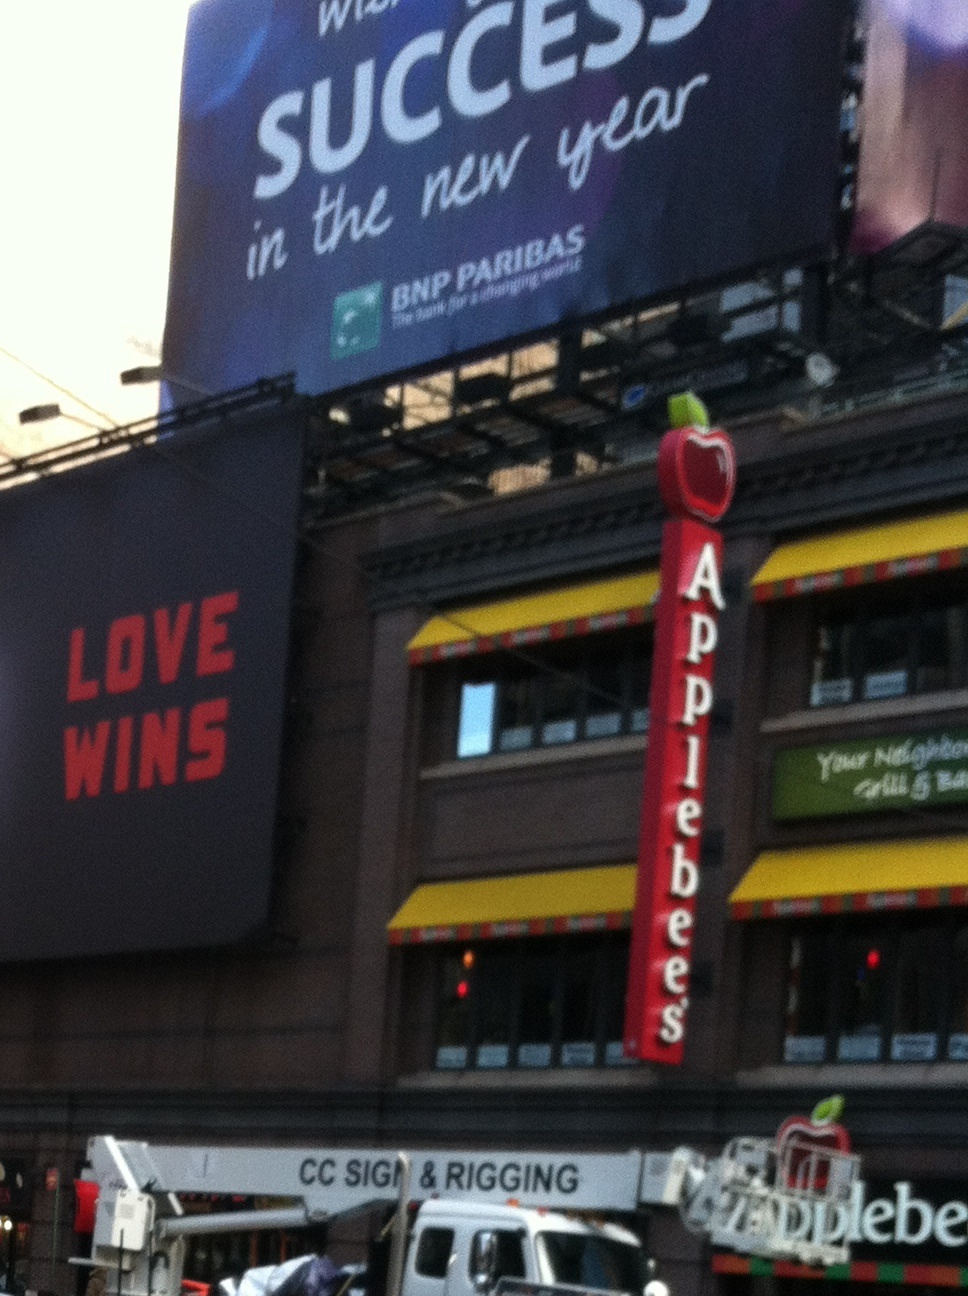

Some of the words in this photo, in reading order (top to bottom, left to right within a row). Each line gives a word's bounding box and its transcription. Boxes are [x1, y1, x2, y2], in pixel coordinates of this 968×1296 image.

[245, 220, 288, 281] in
[312, 184, 394, 256] the
[420, 134, 530, 220] new
[556, 73, 711, 191] year
[390, 269, 451, 313] BNP
[456, 224, 587, 292] PARIBAS
[66, 590, 238, 703] LOVE
[63, 697, 229, 803] WINS
[817, 751, 870, 784] Your
[299, 1157, 336, 1186] CC
[420, 1160, 437, 1189] &
[445, 1161, 580, 1194] RIGGING
